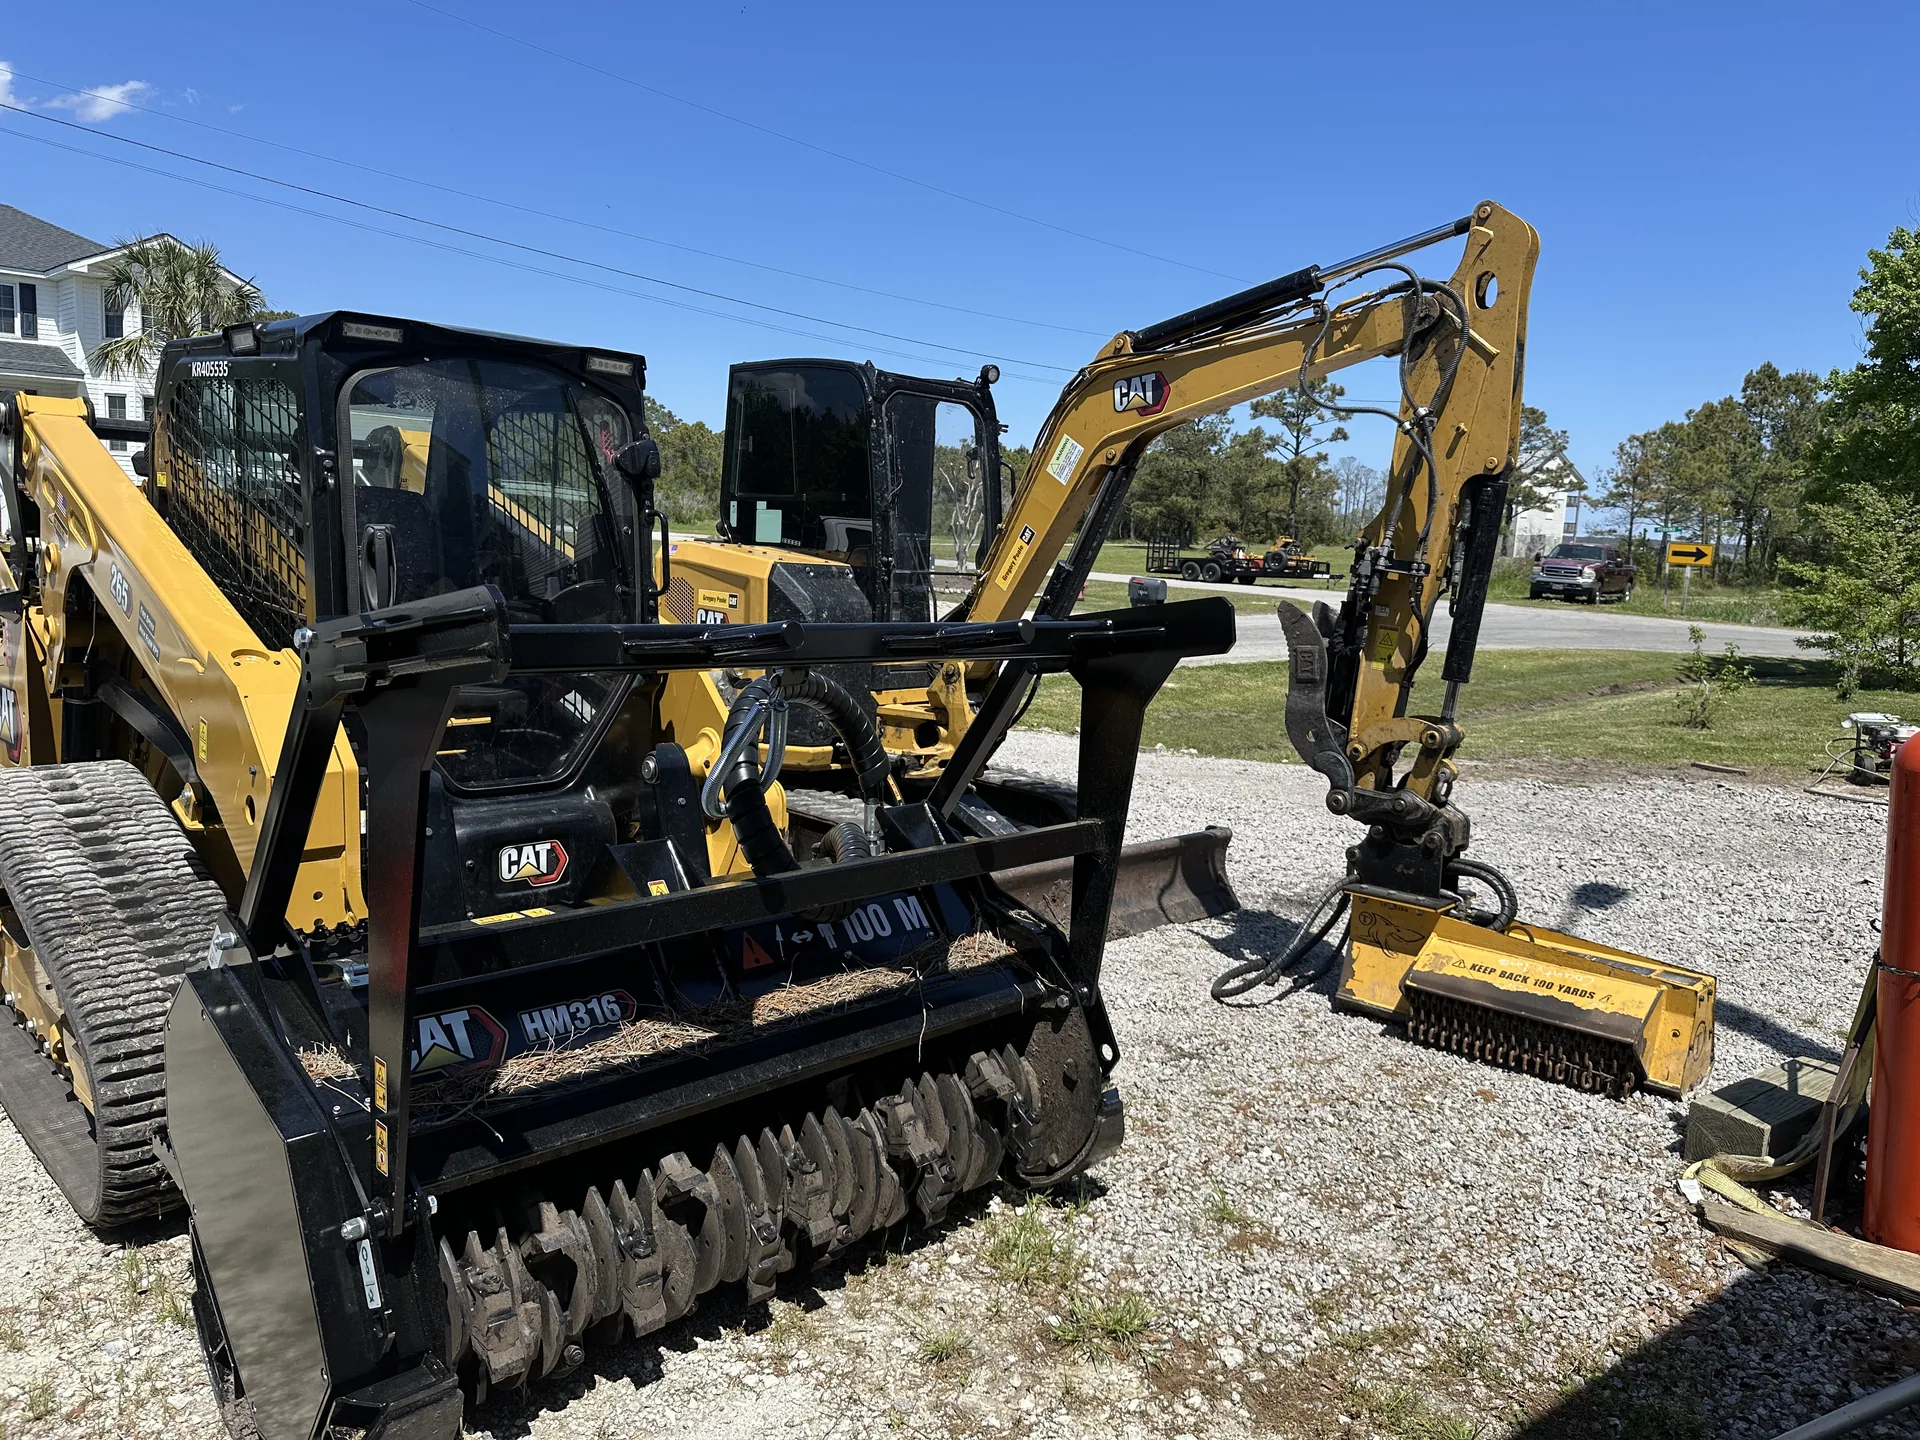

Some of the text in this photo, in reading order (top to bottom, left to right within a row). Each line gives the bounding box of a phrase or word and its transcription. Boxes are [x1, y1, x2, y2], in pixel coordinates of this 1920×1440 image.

[191, 360, 229, 377] KR405535
[1114, 372, 1156, 412] CAT
[1021, 527, 1033, 543] CAT
[1001, 544, 1024, 582] Gregory Poole
[110, 563, 129, 613] 265
[696, 608, 724, 624] CAT
[0, 686, 15, 745] AT
[501, 842, 551, 880] CAT
[840, 895, 930, 944] 100 M
[1469, 963, 1596, 1000] KEEP BACK 100 YARDS
[411, 994, 622, 1072] AT HM316
